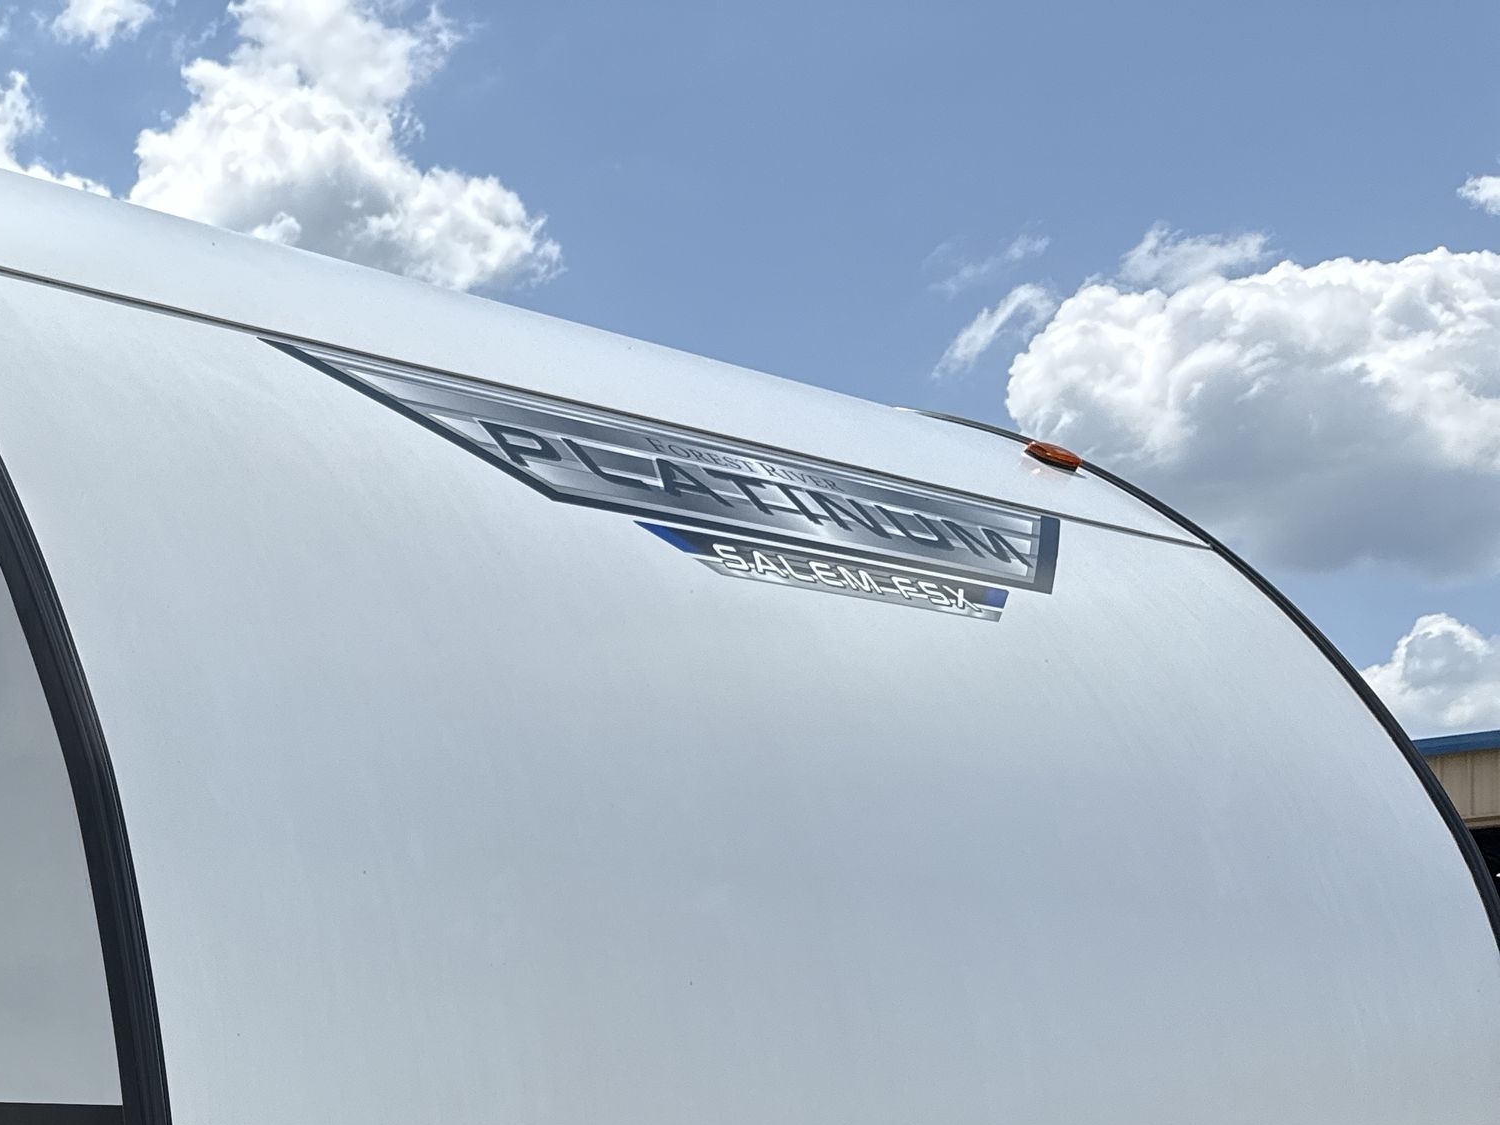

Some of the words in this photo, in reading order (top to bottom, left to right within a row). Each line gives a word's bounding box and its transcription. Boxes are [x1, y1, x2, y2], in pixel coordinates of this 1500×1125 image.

[479, 419, 1032, 568] PLATINUM
[645, 437, 755, 473] FOREST
[757, 461, 846, 493] RIVER
[713, 543, 885, 595] SALEM
[891, 575, 982, 612] FSX
